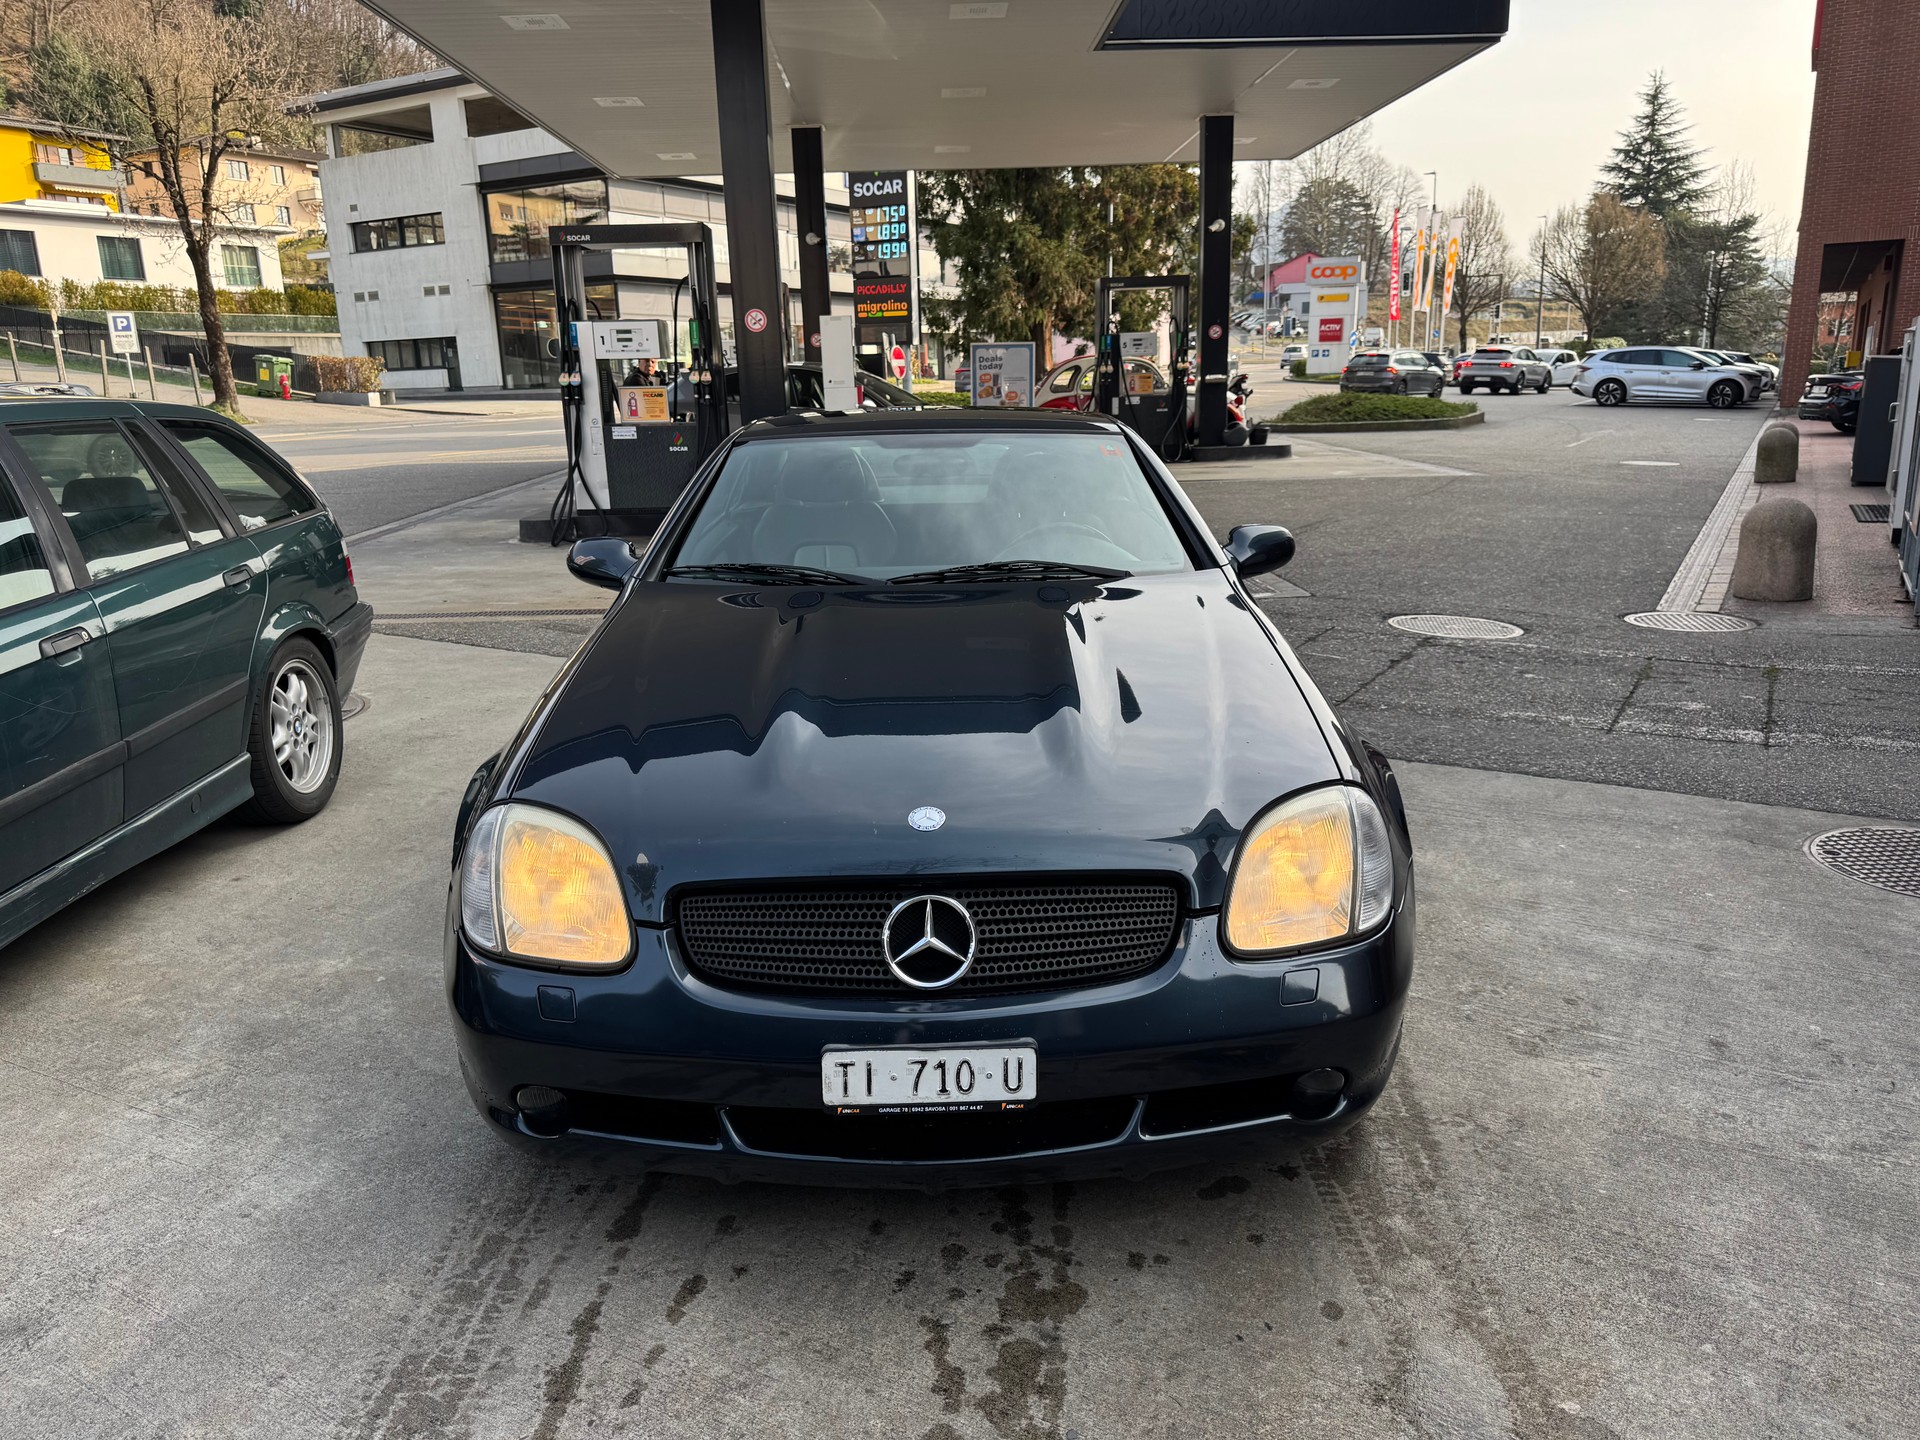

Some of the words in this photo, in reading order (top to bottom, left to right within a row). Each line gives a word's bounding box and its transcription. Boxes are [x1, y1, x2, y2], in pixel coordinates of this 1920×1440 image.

[853, 179, 903, 198] SOCAR
[566, 234, 591, 242] SOCAR
[1311, 265, 1357, 281] coop
[857, 299, 908, 314] migrolino
[116, 317, 128, 330] P
[600, 336, 605, 346] 1
[978, 355, 1003, 363] Deals
[979, 363, 1003, 371] today
[835, 1059, 873, 1098] TI
[907, 1057, 976, 1096] 710
[1002, 1056, 1023, 1094] U
